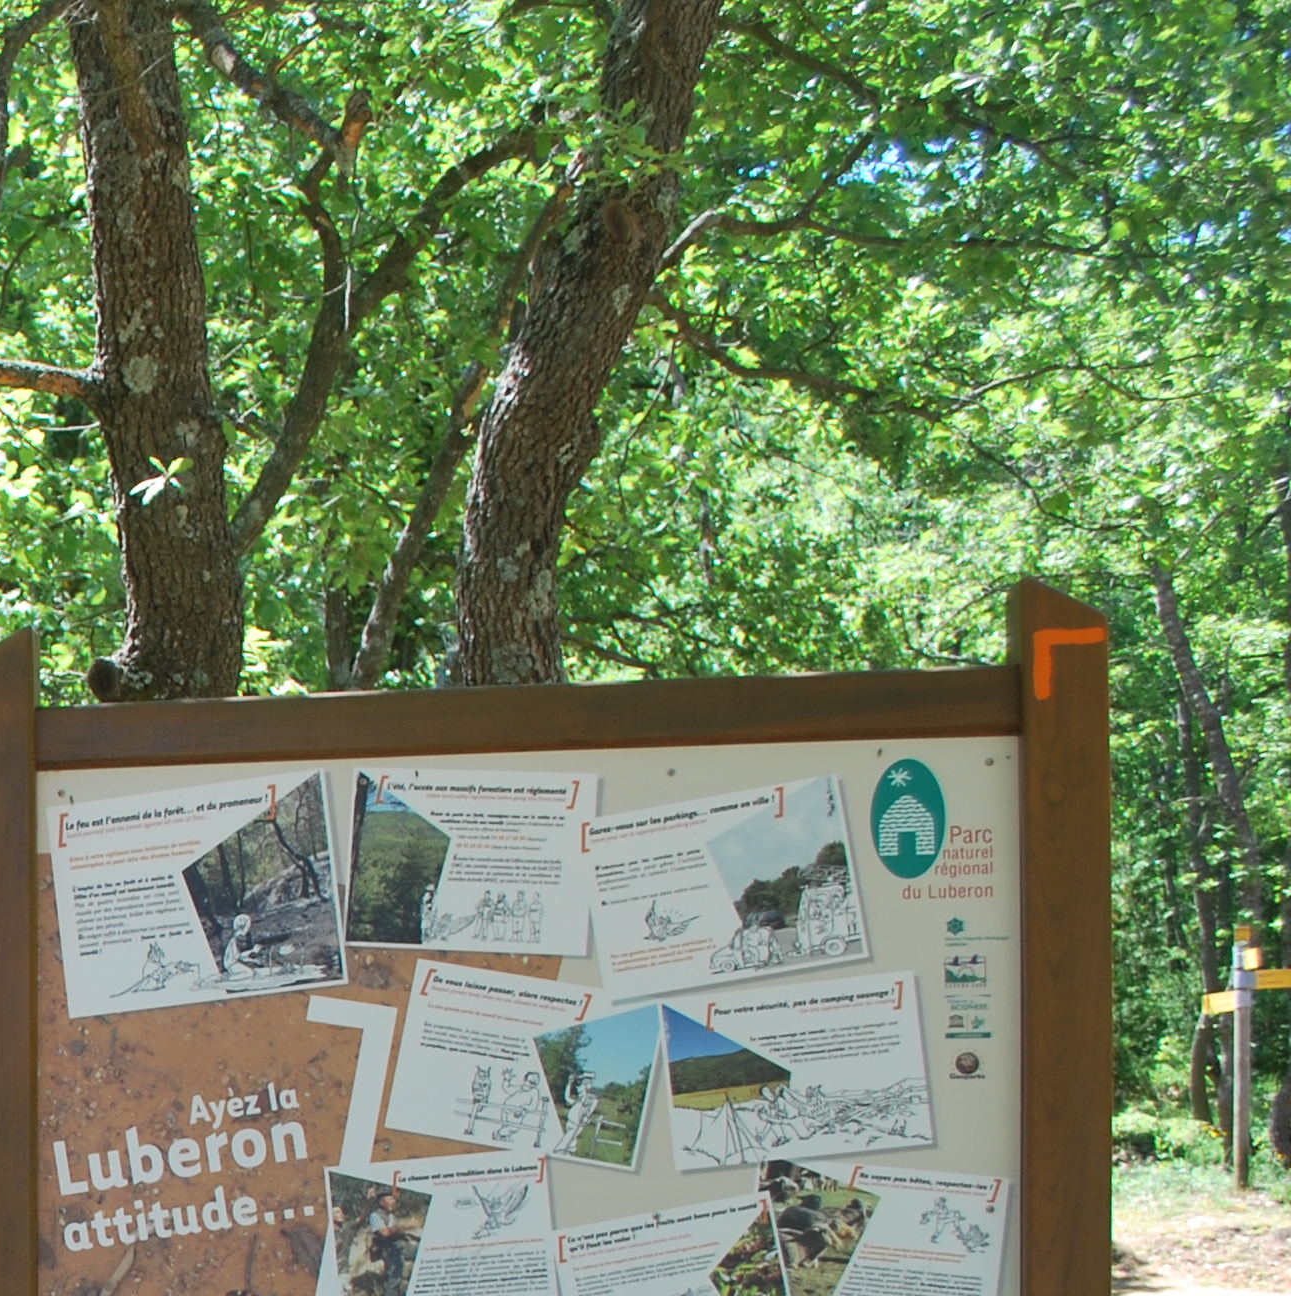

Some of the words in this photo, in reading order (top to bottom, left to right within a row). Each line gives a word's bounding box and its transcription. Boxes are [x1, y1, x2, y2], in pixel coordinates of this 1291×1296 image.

[65, 821, 74, 831] Le
[76, 819, 90, 833] feu
[91, 817, 104, 827] est
[106, 812, 141, 825] l'ennemi
[142, 810, 152, 821] de
[154, 809, 162, 819] la
[196, 803, 205, 813] et
[206, 802, 217, 812] du
[219, 798, 264, 814] promeneur
[588, 820, 634, 836] Garez-vous
[650, 815, 661, 825] les
[710, 804, 739, 814] comme
[752, 795, 770, 807] ville
[949, 825, 993, 844] Parc
[942, 846, 993, 860] naturel
[934, 861, 993, 878] régional
[902, 885, 921, 899] du
[928, 884, 993, 899] Luberon
[714, 1006, 731, 1016] Pour
[734, 1003, 754, 1014] votre
[756, 999, 790, 1014] sécurité,
[792, 1000, 807, 1009] pas
[808, 996, 819, 1005] de
[820, 992, 854, 1006] camping
[857, 990, 890, 1002] sauvage
[189, 1094, 261, 1129] Ayez
[268, 1082, 299, 1111] la
[53, 1121, 308, 1196] Luberon
[63, 1185, 315, 1251] attitude...
